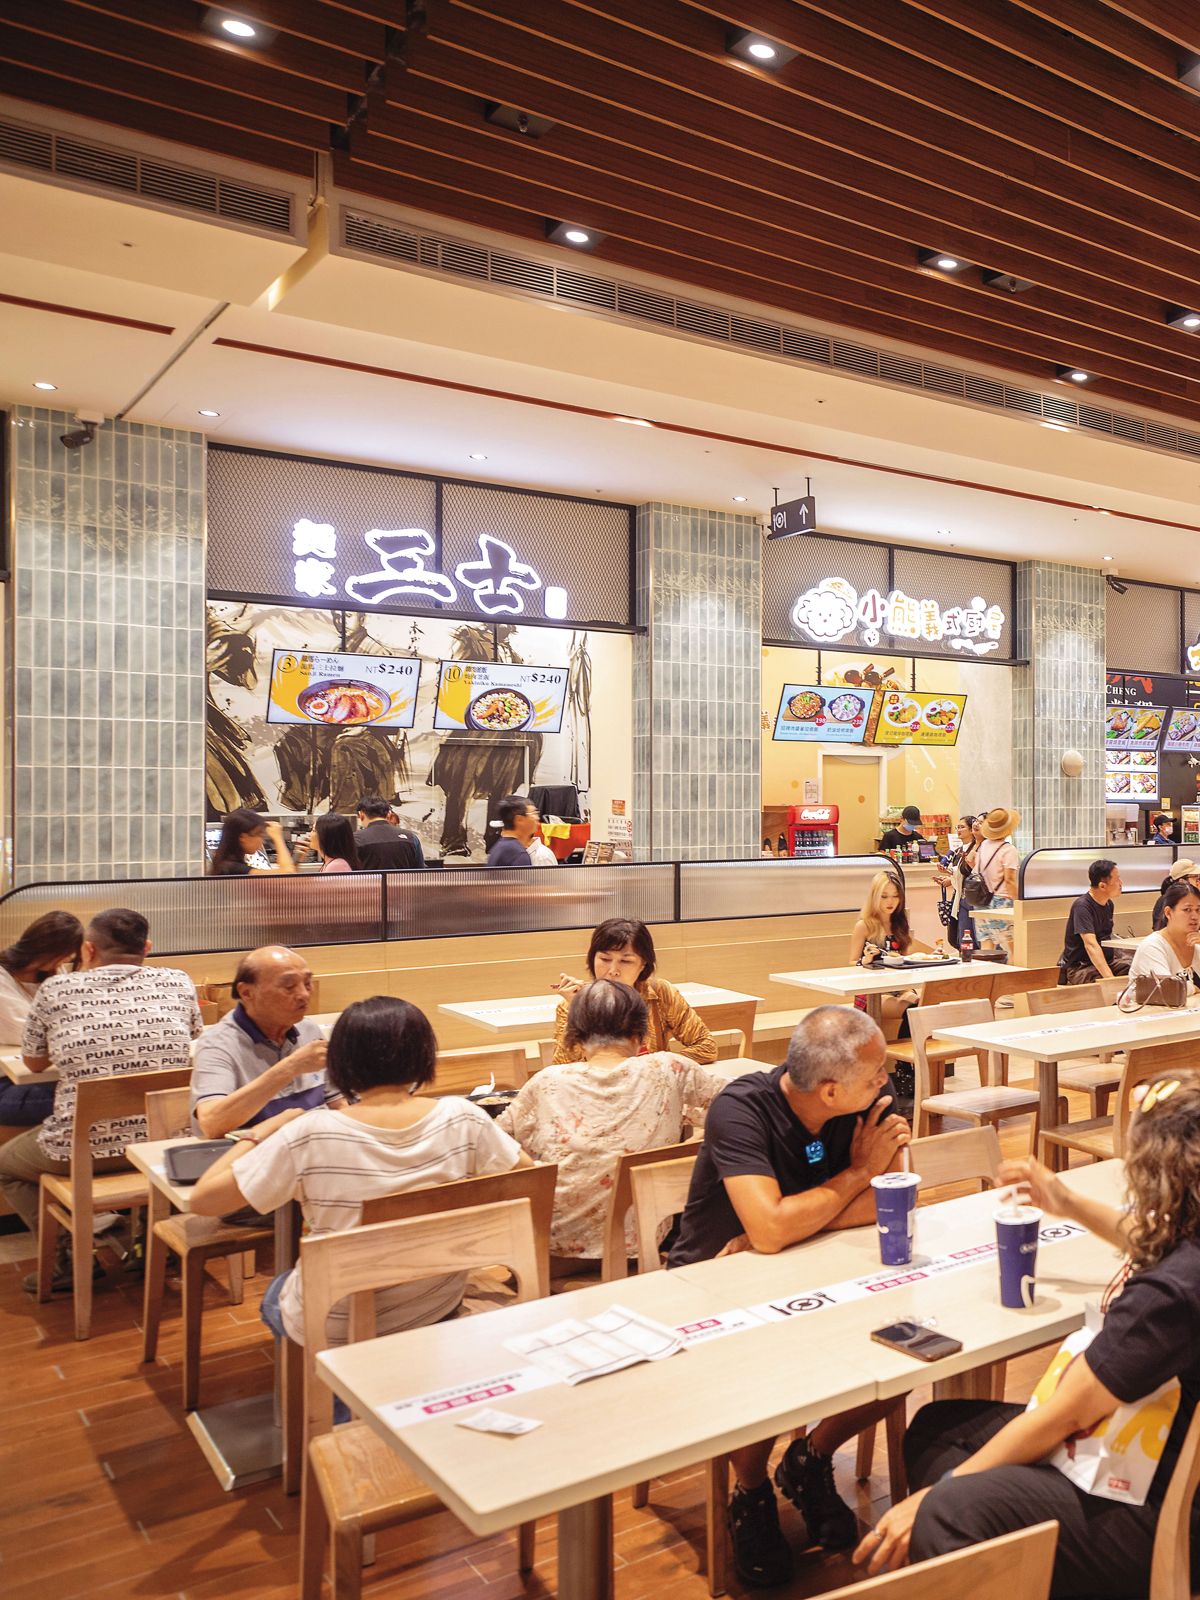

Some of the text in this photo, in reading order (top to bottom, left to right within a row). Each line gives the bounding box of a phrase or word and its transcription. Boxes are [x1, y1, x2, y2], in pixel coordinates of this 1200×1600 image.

[448, 668, 461, 679] 10
[58, 981, 184, 997] PUMA PUMA PUMA
[81, 999, 120, 1007] PUMA
[134, 994, 168, 1002] PUMA
[60, 1012, 95, 1024] PUMA
[109, 1007, 148, 1016] PUMA
[83, 1022, 123, 1032] PUMA
[137, 1017, 172, 1025] PUMA
[62, 1038, 97, 1050] PUMA
[111, 1031, 151, 1042] PUMA
[86, 1049, 125, 1060] PUMA
[138, 1043, 174, 1052] PUMA
[67, 1067, 100, 1078] PUMA
[112, 1060, 150, 1071] PUMA
[110, 1117, 147, 1130] PUMA
[89, 1135, 122, 1146] UMA
